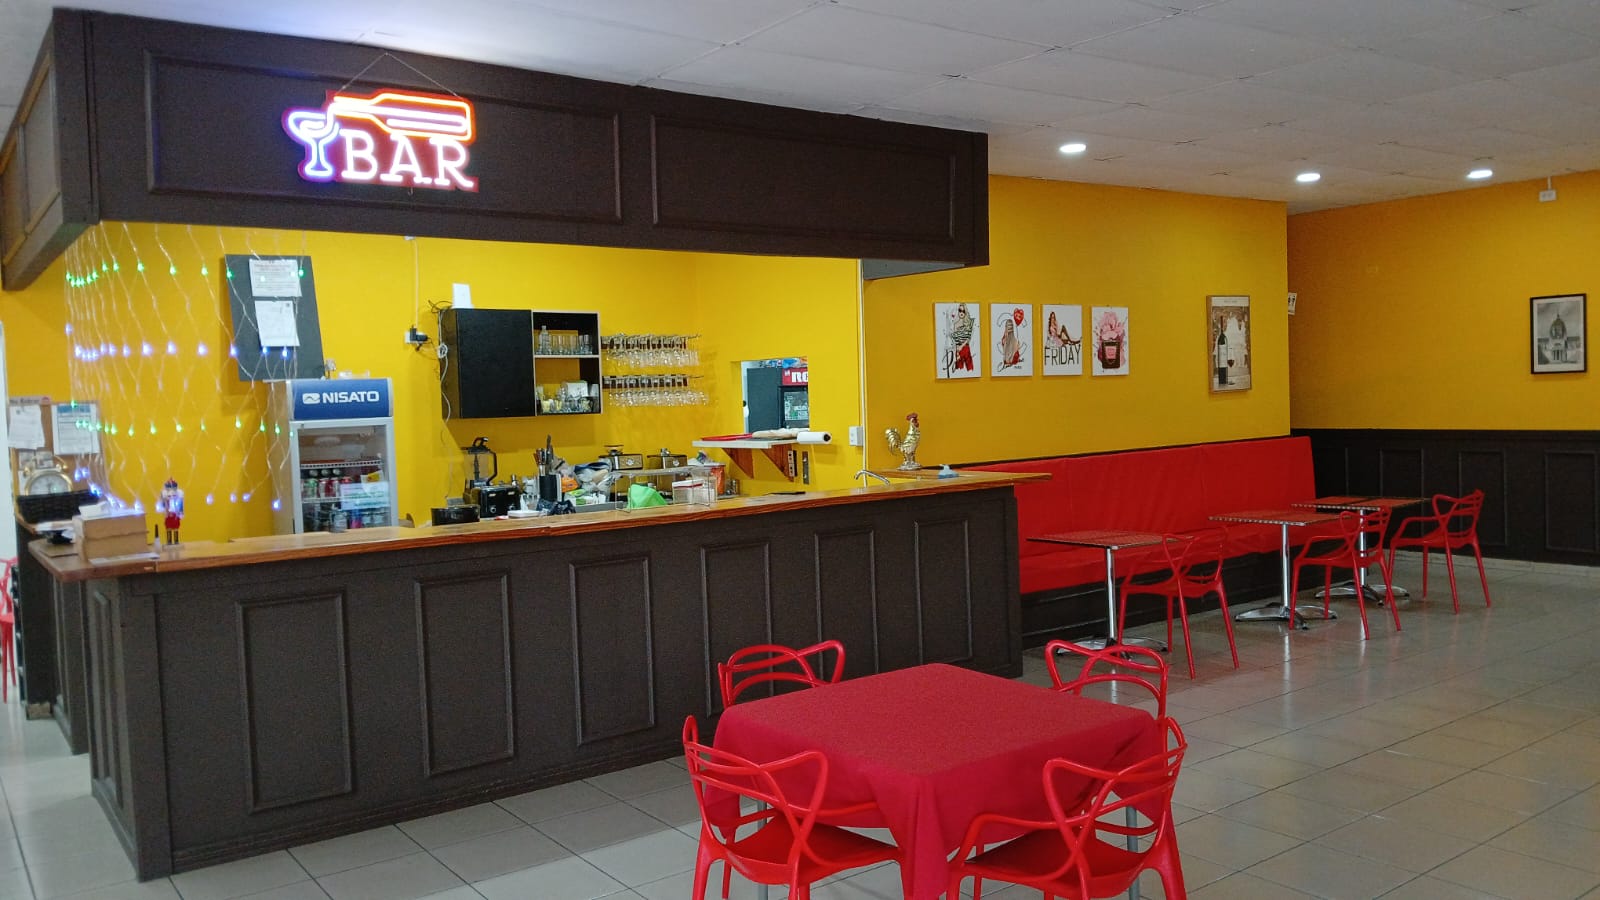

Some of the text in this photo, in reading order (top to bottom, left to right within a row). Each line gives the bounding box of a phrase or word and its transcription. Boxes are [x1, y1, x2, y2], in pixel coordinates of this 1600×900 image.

[338, 128, 474, 188] BAR
[1044, 344, 1081, 366] FRIDAY
[322, 391, 379, 404] NISATO
